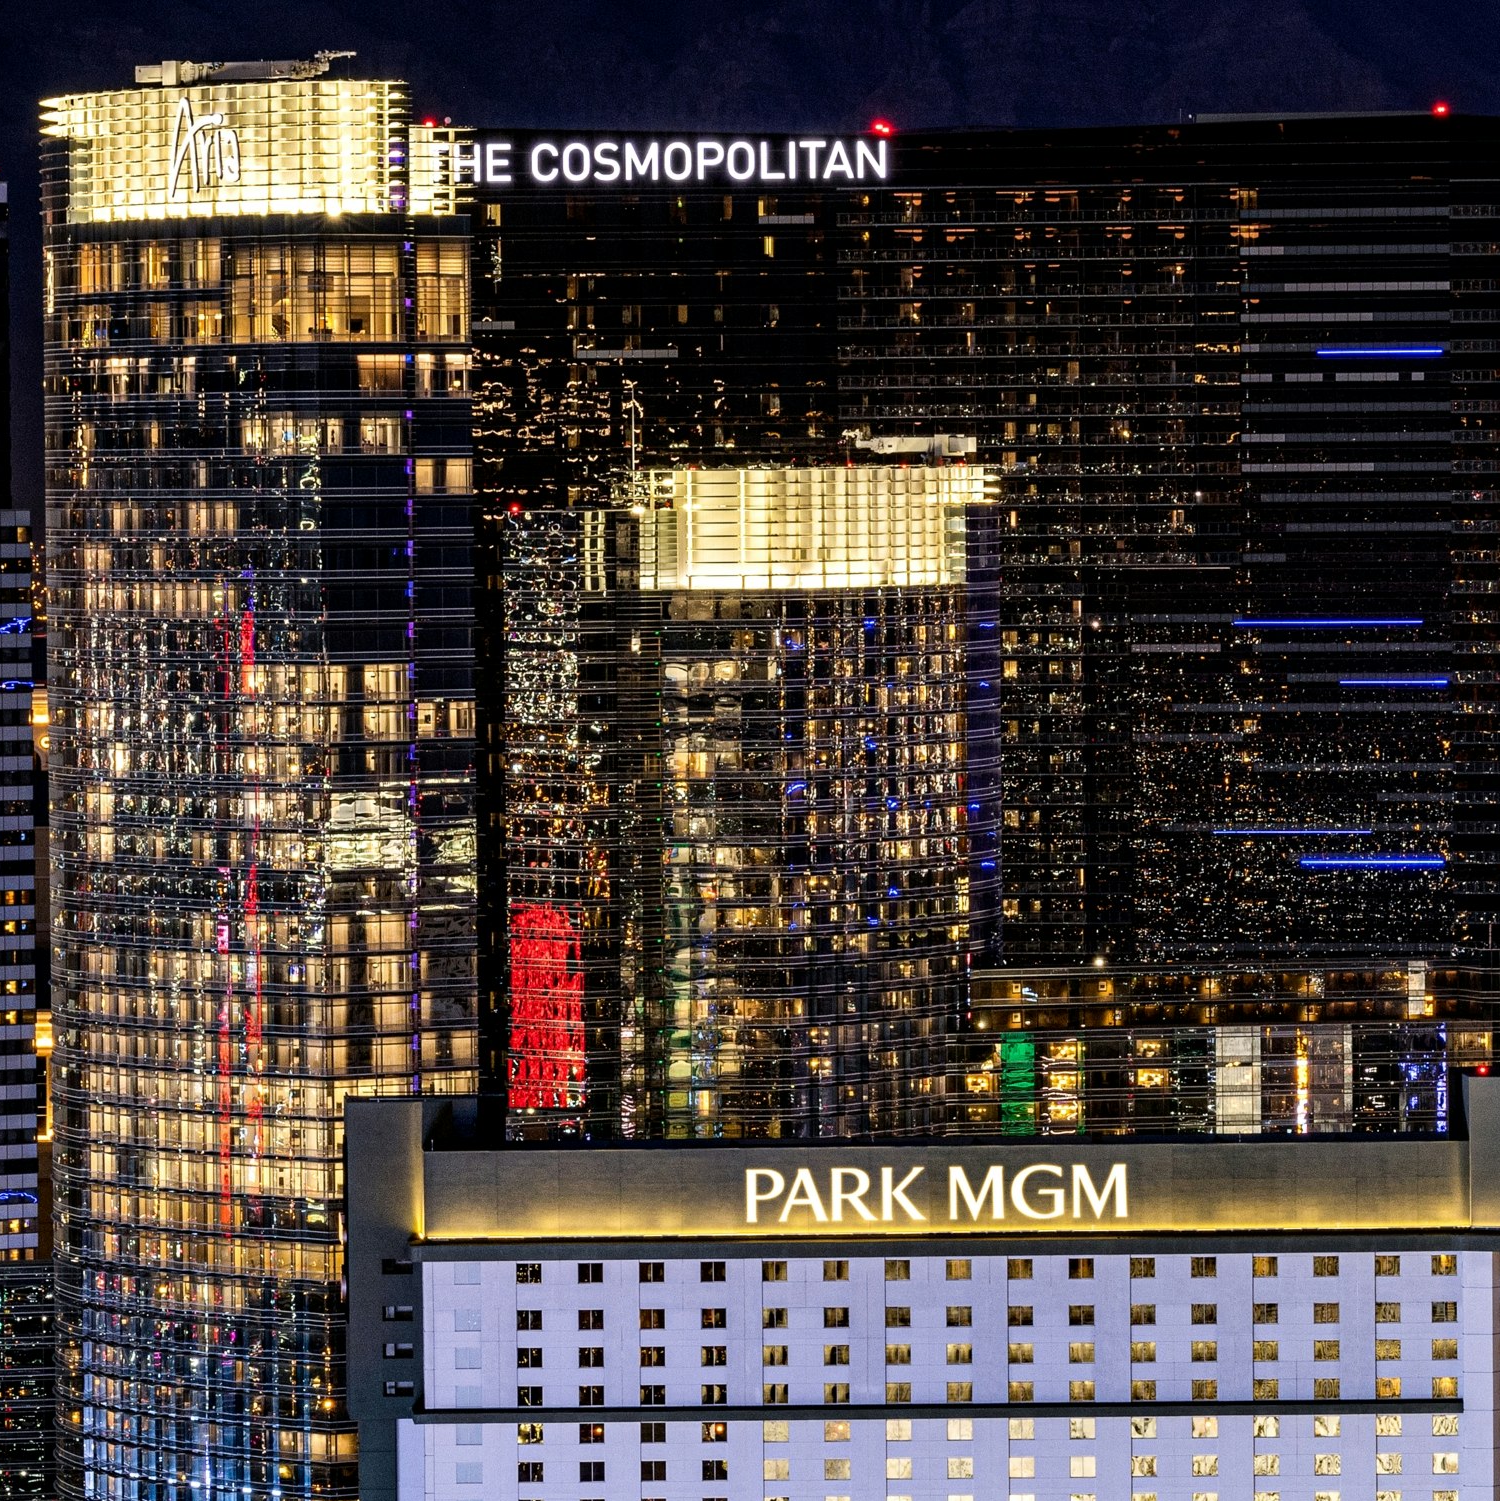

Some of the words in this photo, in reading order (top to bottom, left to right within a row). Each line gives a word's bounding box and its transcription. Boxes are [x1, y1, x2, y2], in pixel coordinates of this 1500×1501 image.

[530, 139, 887, 183] COSMOPOLITAN
[744, 1165, 928, 1224] PARK
[948, 1162, 1129, 1221] MGM
